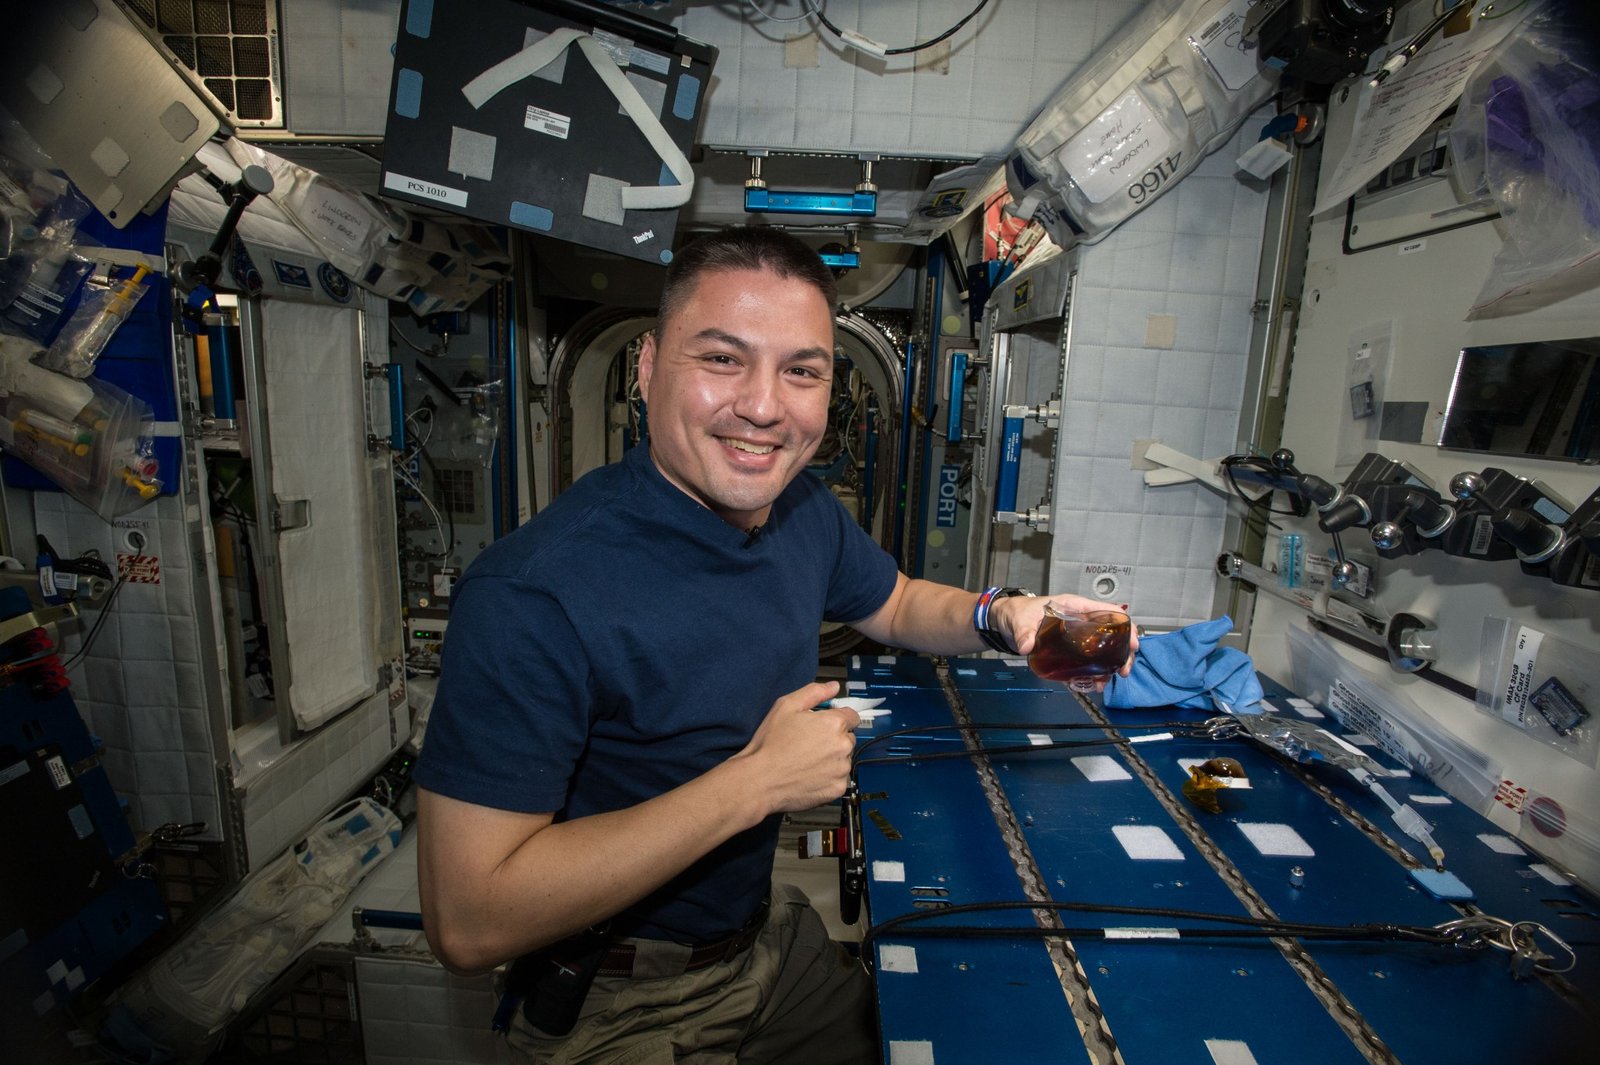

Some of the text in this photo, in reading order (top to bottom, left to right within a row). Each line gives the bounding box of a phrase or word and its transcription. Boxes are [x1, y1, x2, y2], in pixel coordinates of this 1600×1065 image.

[407, 182, 447, 198] PCS 1010
[1128, 151, 1182, 204] 4166
[633, 229, 655, 244] ThinkPad
[938, 469, 958, 525] PORT
[1505, 664, 1520, 704] IMAX 32GB
[1514, 672, 1526, 703] CF Card
